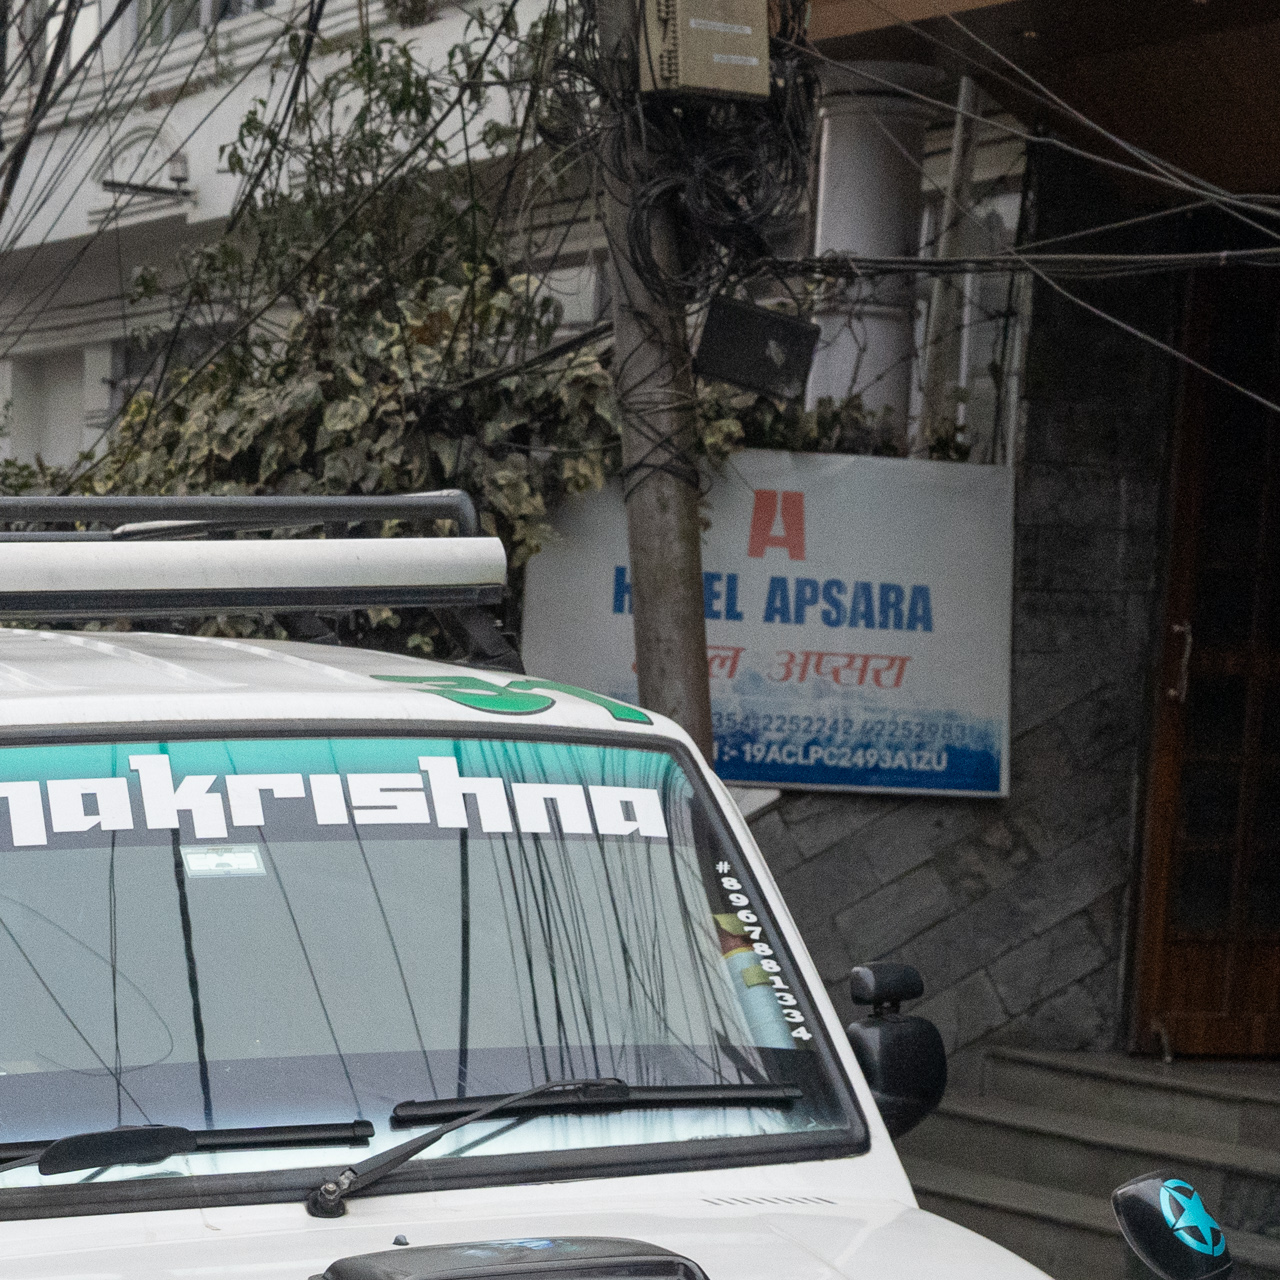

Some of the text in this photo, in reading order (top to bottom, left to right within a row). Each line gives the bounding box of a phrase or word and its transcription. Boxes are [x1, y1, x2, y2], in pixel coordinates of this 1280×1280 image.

[747, 488, 807, 561] A
[612, 565, 934, 632] HEL APSARA
[767, 648, 913, 689] अप्सरा
[715, 860, 813, 1041] #8967881334
